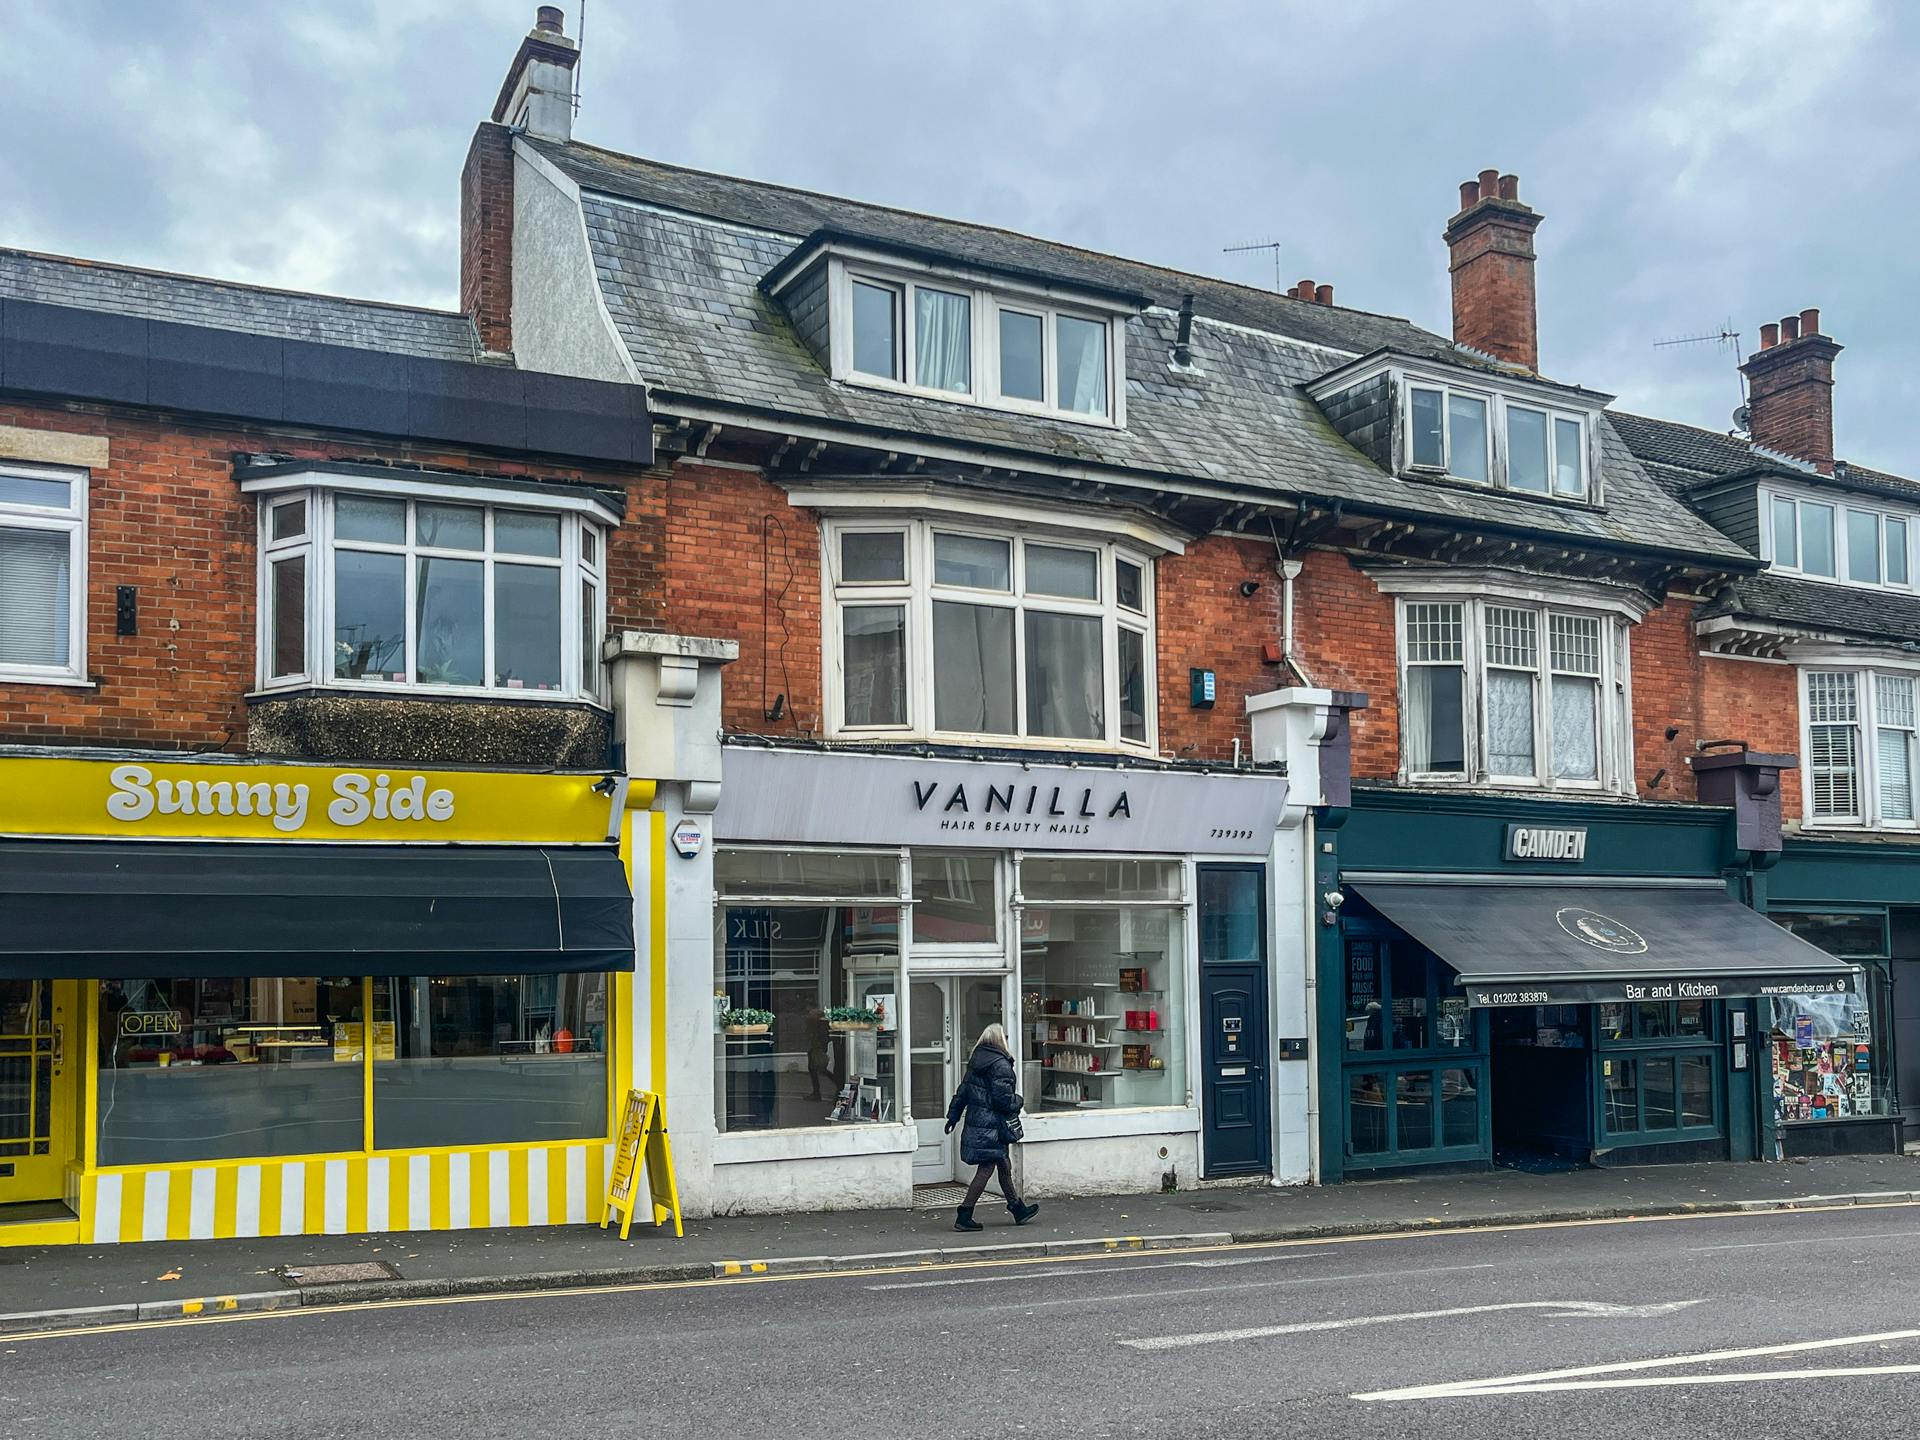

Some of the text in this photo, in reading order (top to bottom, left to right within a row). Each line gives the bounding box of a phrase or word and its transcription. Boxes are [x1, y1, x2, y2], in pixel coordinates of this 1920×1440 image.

[107, 765, 455, 831] Sunny Side
[914, 780, 1131, 819] VANILLA
[940, 819, 1090, 835] HAIR BEAUTY NAILS
[1211, 829, 1253, 840] 739393
[1512, 827, 1586, 860] CAMDEN
[1352, 957, 1374, 971] FOOD
[1352, 982, 1374, 993] MUSIC
[1626, 983, 1719, 998] Bar and Kitchen
[1761, 983, 1834, 995] www.camdenbar.co.uk
[1478, 991, 1548, 1004] Tel. 01202 383879
[124, 1013, 178, 1033] OPEN
[1295, 1042, 1300, 1050] 2
